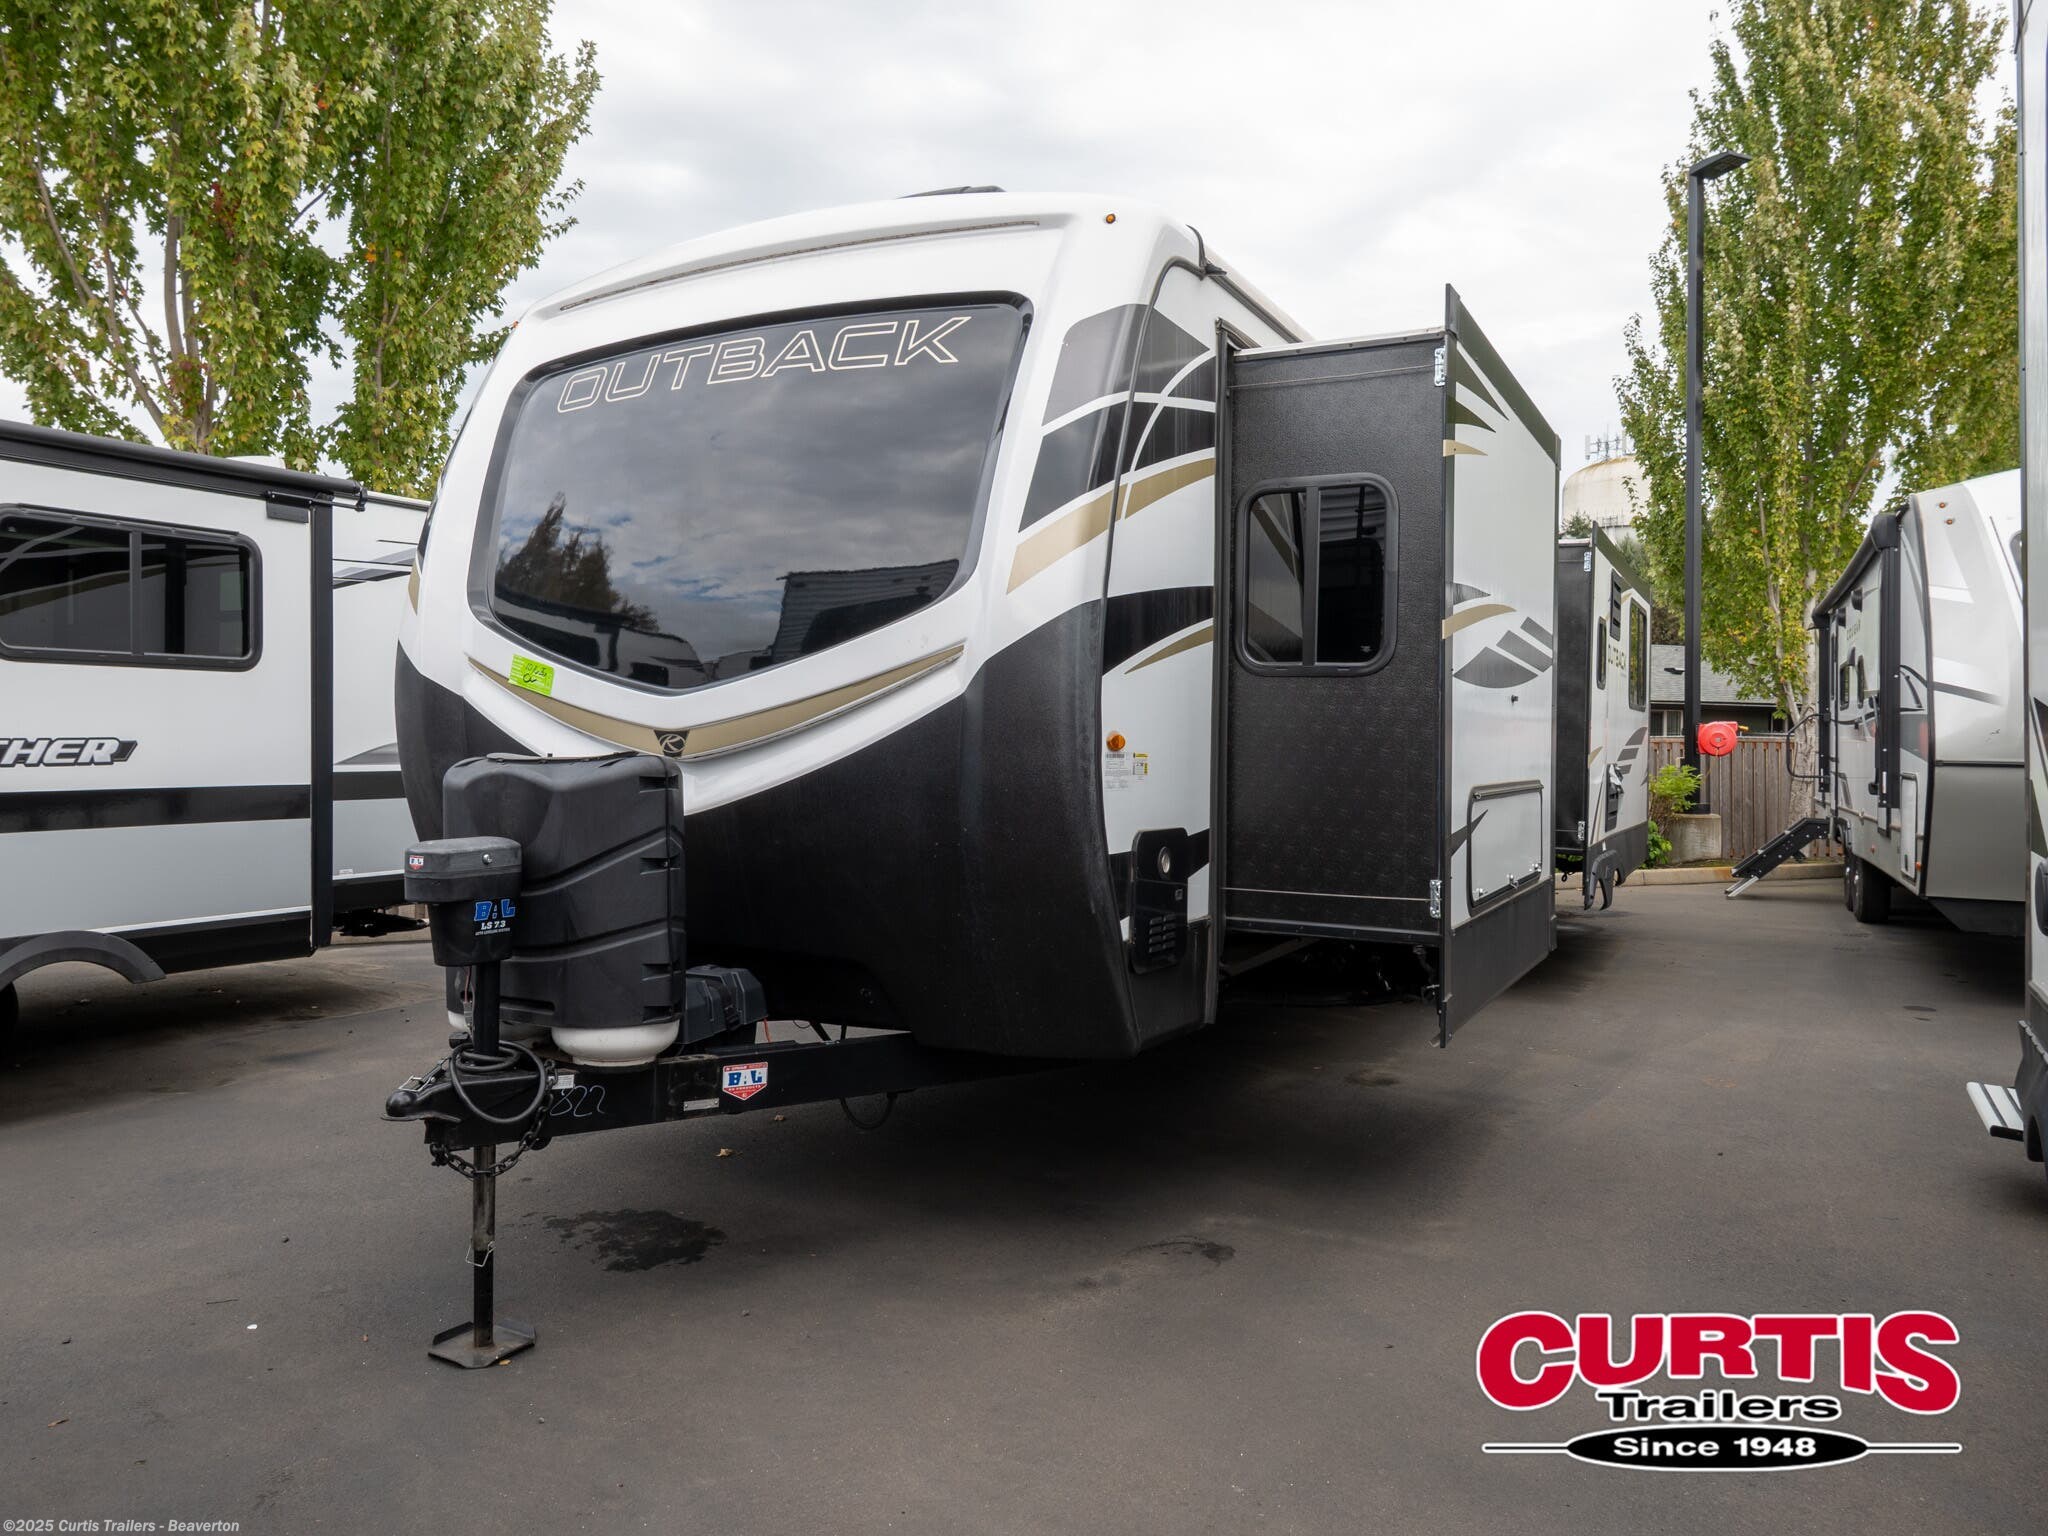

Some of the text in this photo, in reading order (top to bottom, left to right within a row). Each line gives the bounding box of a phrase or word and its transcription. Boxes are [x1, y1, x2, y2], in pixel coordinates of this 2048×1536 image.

[557, 316, 972, 413] OUTBACK
[0, 737, 119, 767] HER
[481, 921, 493, 930] LS
